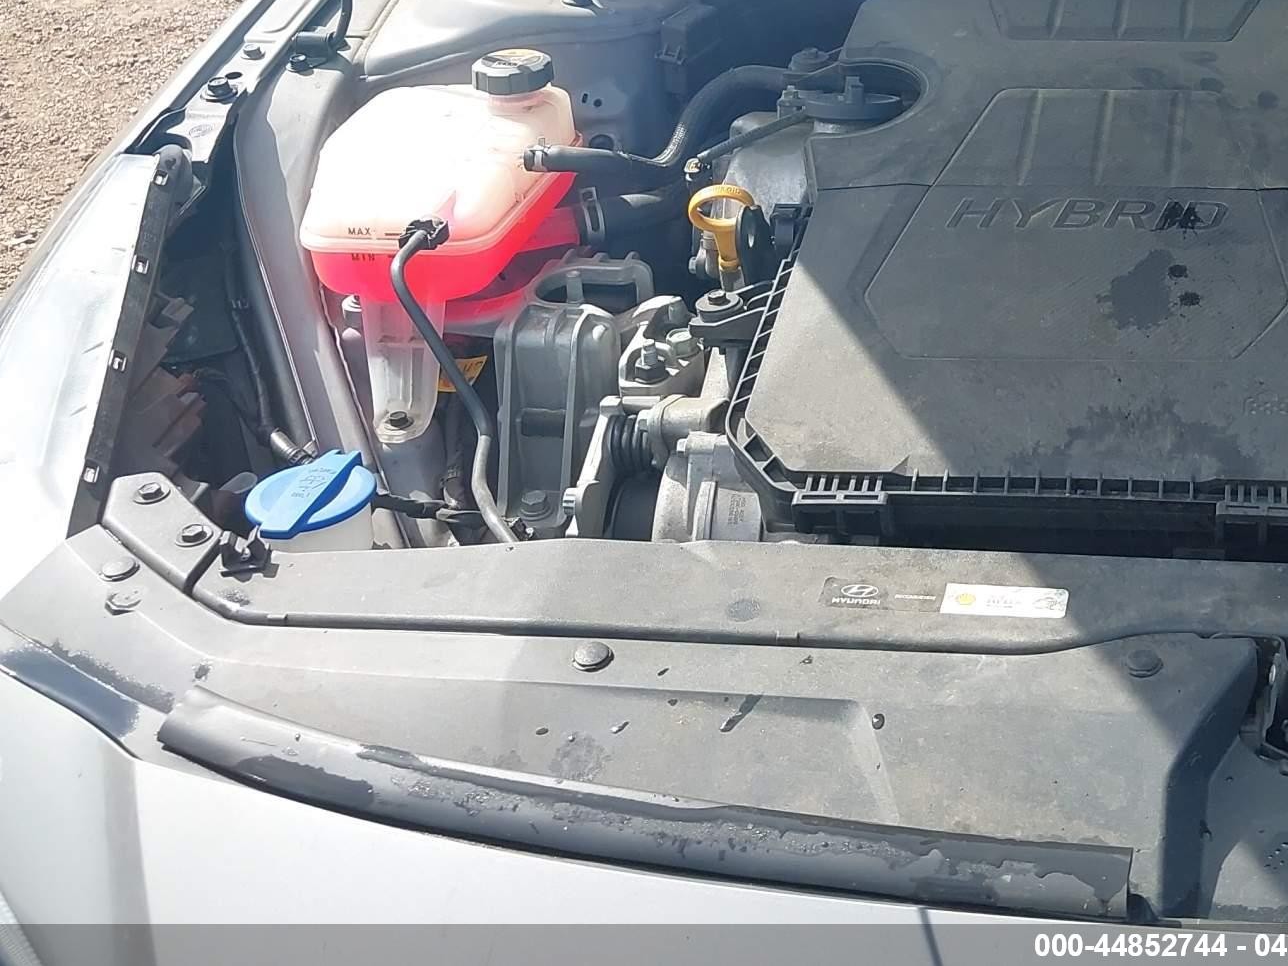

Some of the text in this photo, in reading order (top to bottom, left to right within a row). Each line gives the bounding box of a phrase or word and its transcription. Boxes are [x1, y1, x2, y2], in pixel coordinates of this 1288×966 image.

[945, 197, 1230, 230] HYBRID
[348, 227, 371, 236] MAX
[351, 253, 375, 262] MIN
[831, 596, 880, 605] HYUNDAI
